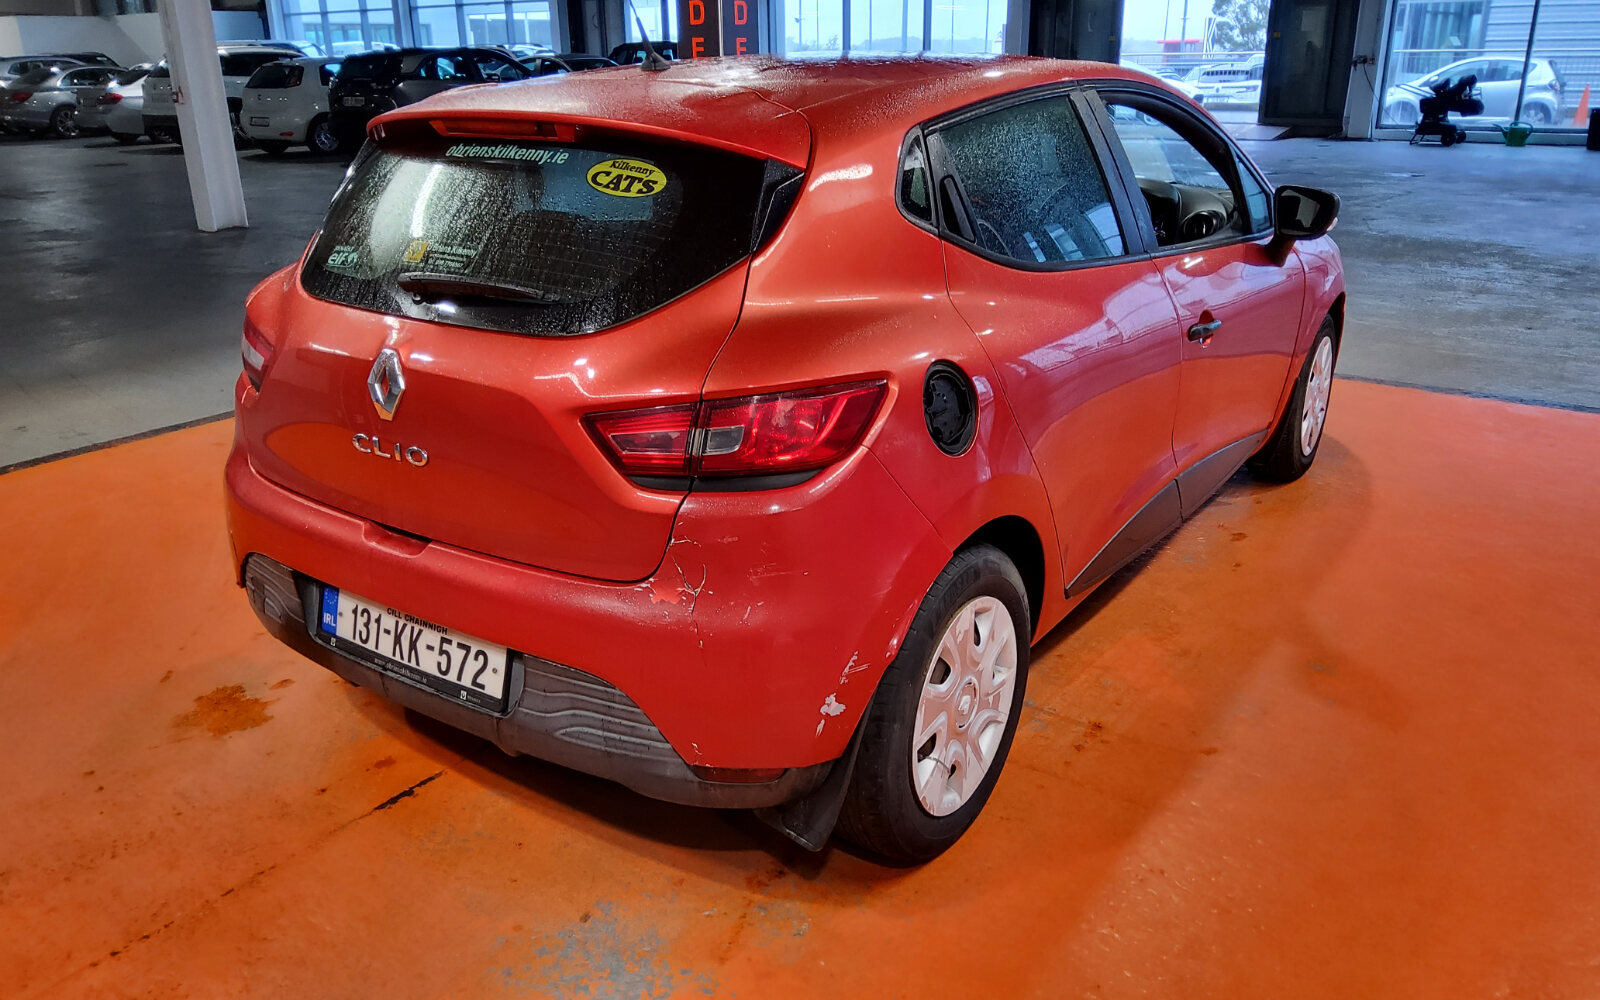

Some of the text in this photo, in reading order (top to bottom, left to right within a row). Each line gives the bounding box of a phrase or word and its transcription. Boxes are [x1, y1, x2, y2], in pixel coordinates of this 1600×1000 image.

[445, 143, 570, 165] obrienskilkenny.ie
[609, 159, 656, 178] Kilkenny
[590, 170, 659, 195] CATS
[351, 433, 428, 467] CLIO
[323, 612, 336, 627] IRL
[386, 607, 448, 636] CILL CHAINNIGH
[351, 603, 490, 691] 131-KK-572
